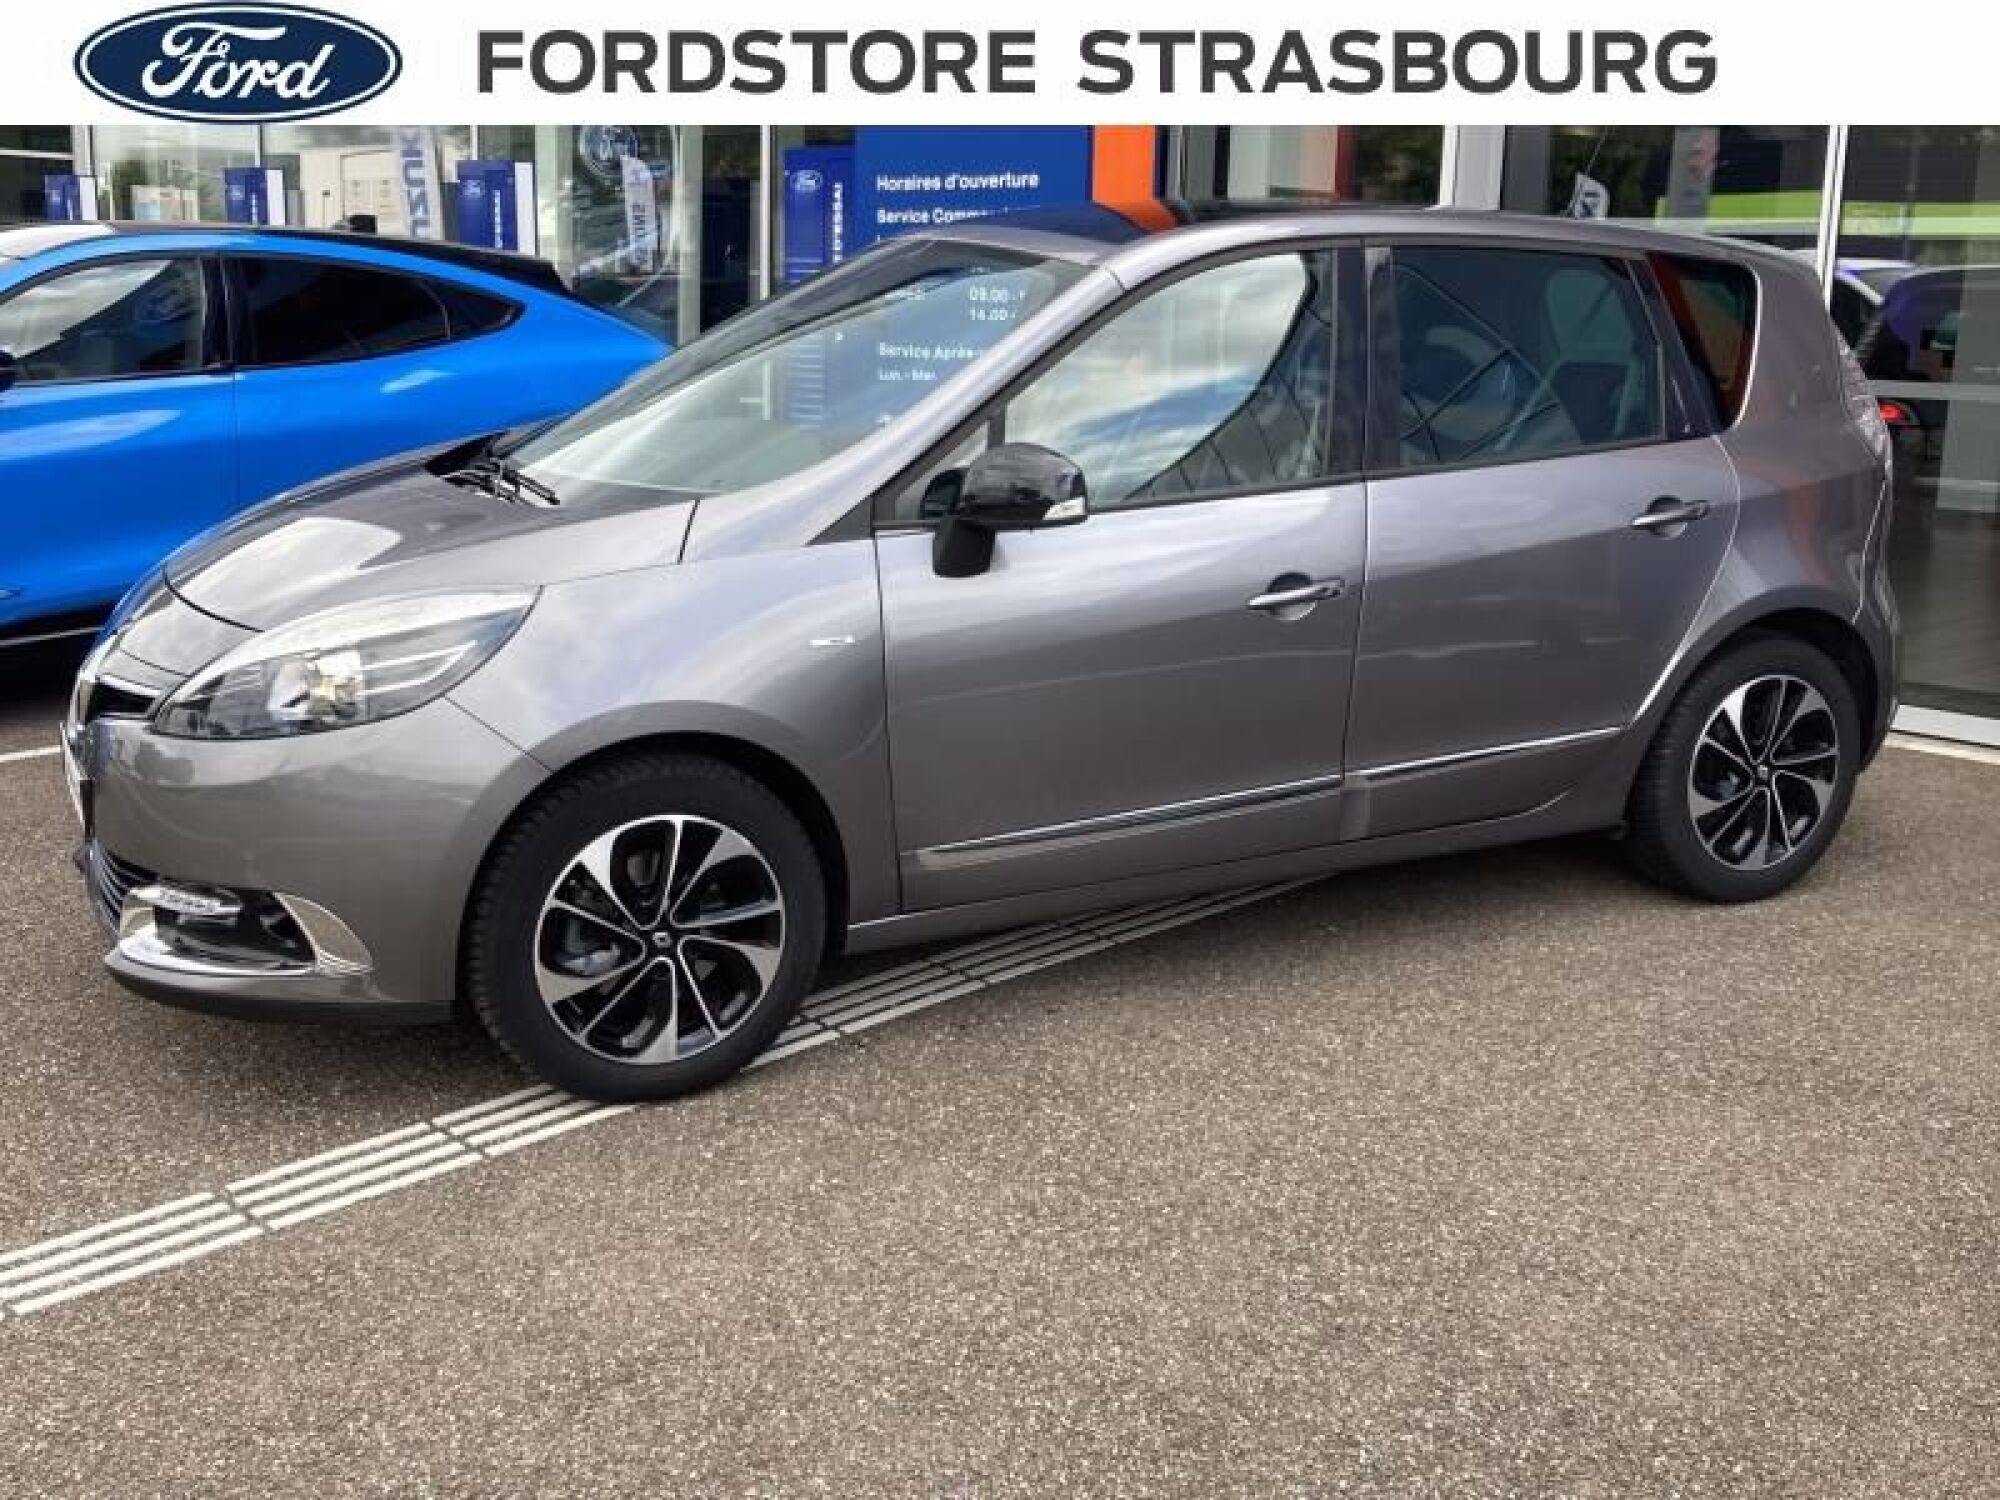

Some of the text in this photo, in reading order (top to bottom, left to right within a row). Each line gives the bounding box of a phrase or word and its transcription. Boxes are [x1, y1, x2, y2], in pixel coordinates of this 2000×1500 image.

[876, 172, 1040, 191] Horaires d'ouverture
[876, 207, 930, 223] Service
[879, 342, 931, 360] Service
